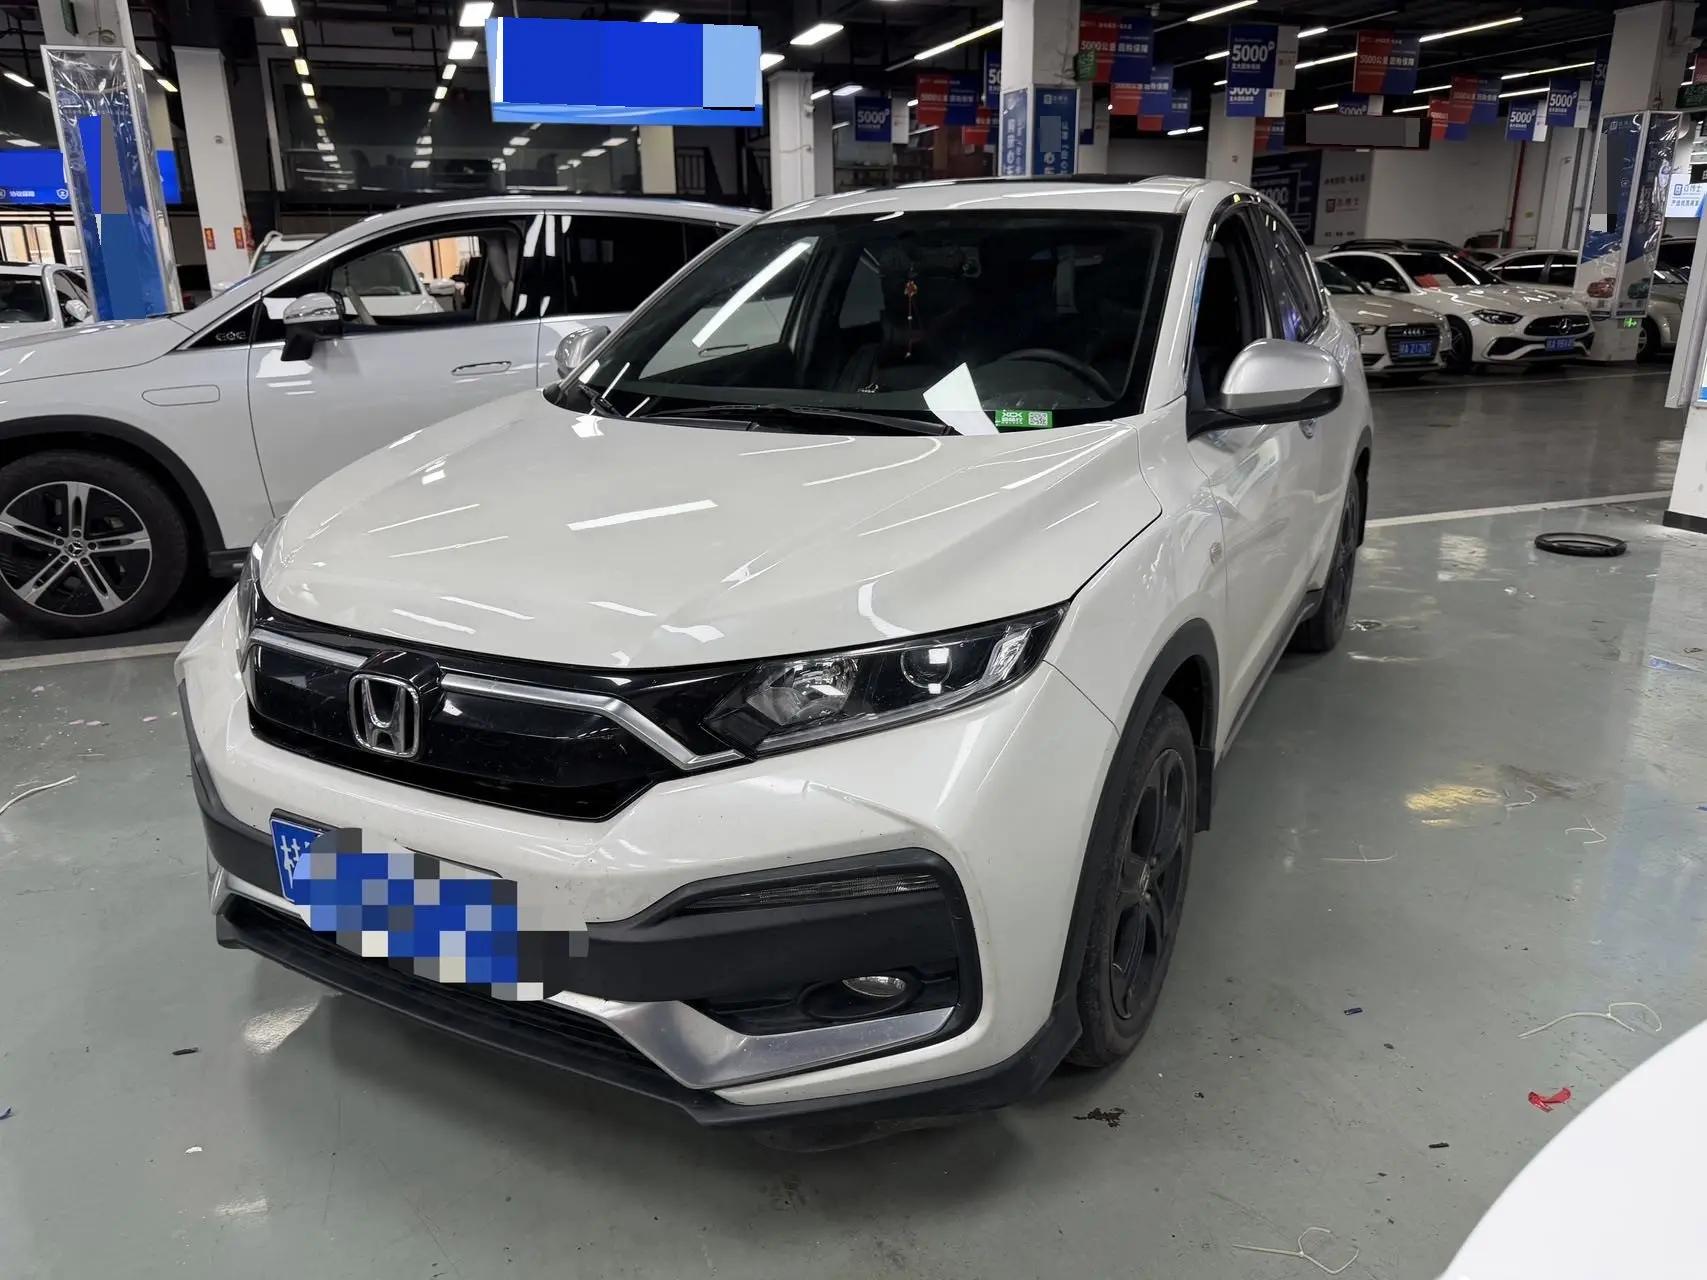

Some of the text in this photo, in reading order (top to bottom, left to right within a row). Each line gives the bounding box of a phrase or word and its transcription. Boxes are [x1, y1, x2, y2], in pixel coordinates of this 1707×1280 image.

[1232, 44, 1268, 62] 5000
[1549, 94, 1573, 108] 5000
[857, 110, 887, 124] 5000
[1510, 111, 1532, 124] 5000
